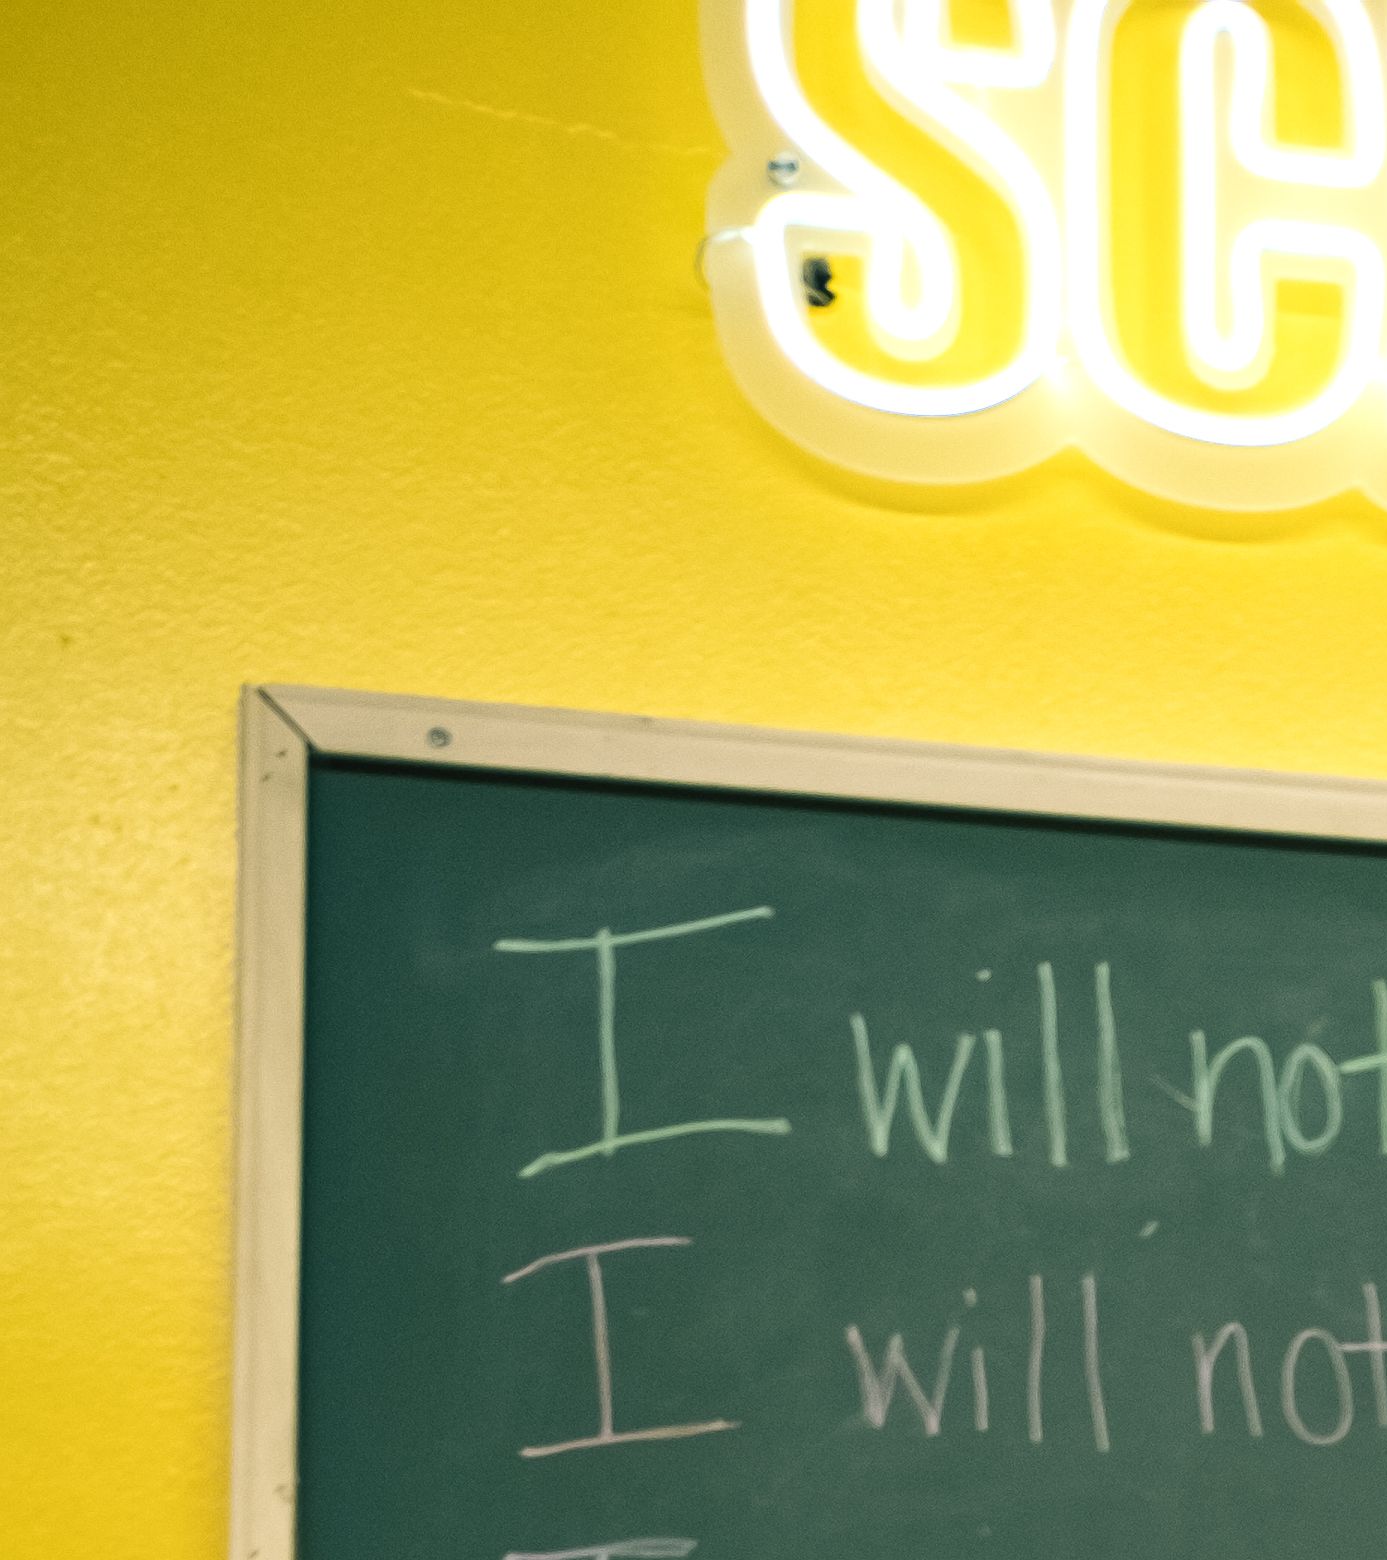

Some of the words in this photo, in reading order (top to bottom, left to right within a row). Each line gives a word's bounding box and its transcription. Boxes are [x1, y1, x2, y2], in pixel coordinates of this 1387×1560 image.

[494, 904, 793, 1178] I
[851, 960, 1129, 1166] will
[502, 1236, 742, 1459] I
[846, 1271, 1110, 1453] will
